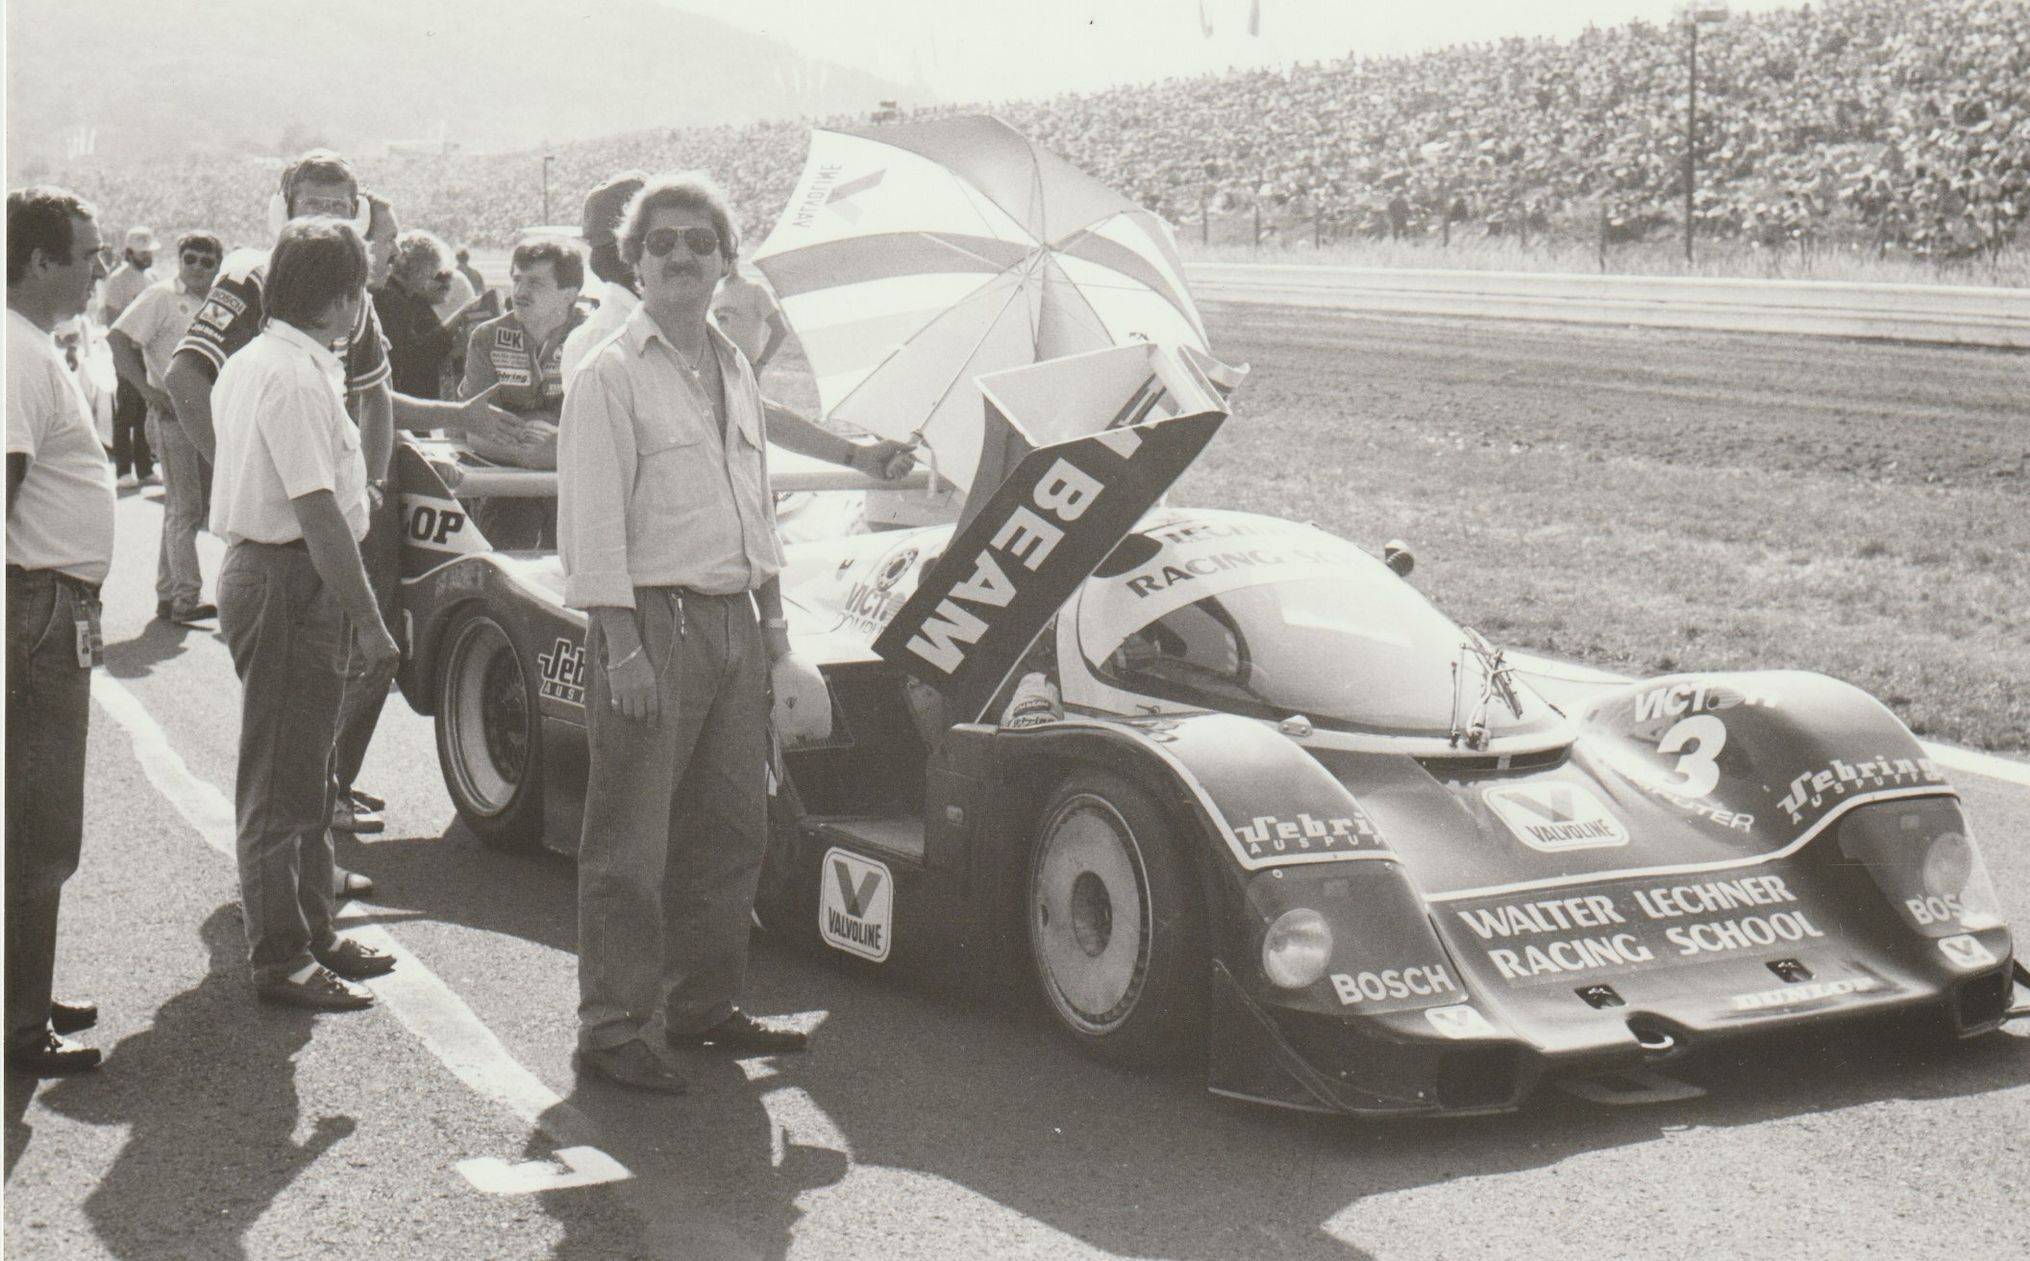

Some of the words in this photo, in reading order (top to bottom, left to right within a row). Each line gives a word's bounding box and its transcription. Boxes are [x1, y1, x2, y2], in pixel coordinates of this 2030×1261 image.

[906, 457, 1105, 674] BEAM
[1126, 549, 1284, 598] RACING
[1657, 714, 1727, 799] 3
[1776, 755, 1944, 815] Sebring
[1525, 818, 1615, 843] VALVOLINE
[828, 906, 882, 950] VALVOLINE
[1458, 895, 1626, 939] WALTER
[1633, 875, 1797, 919] LECHNER
[1488, 933, 1655, 979] RACING
[1665, 911, 1824, 956] SCHOOL
[1330, 964, 1456, 1006] BOSCH
